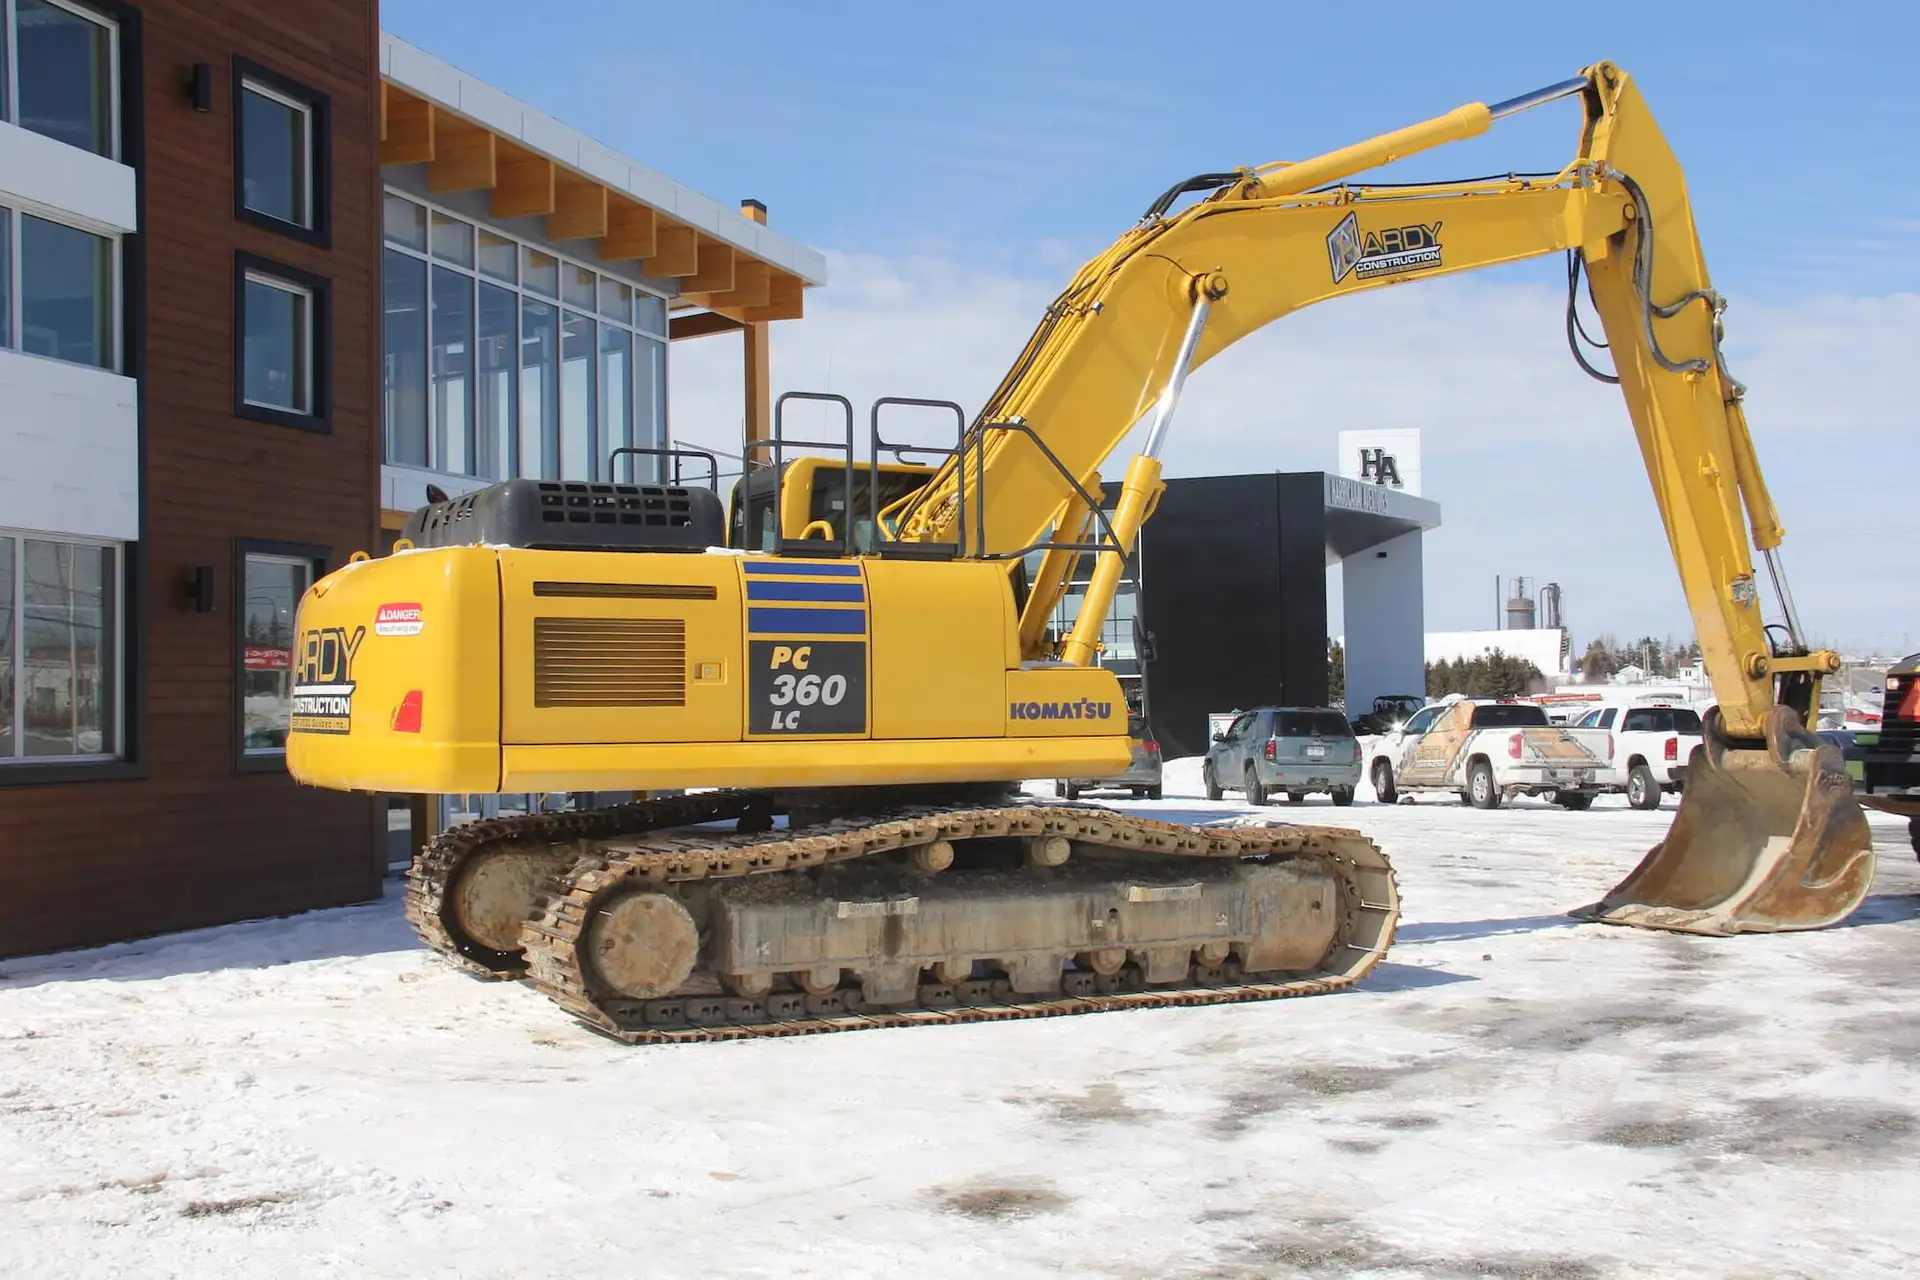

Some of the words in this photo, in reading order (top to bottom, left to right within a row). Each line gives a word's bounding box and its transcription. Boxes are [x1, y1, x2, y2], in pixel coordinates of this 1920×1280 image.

[1355, 251, 1440, 272] CONSTRUCTION
[1360, 448, 1400, 485] HA
[385, 608, 420, 620] DANGER
[770, 646, 812, 670] PC
[769, 674, 847, 706] 360
[1010, 698, 1112, 719] KOMATSU
[770, 710, 801, 730] LC
